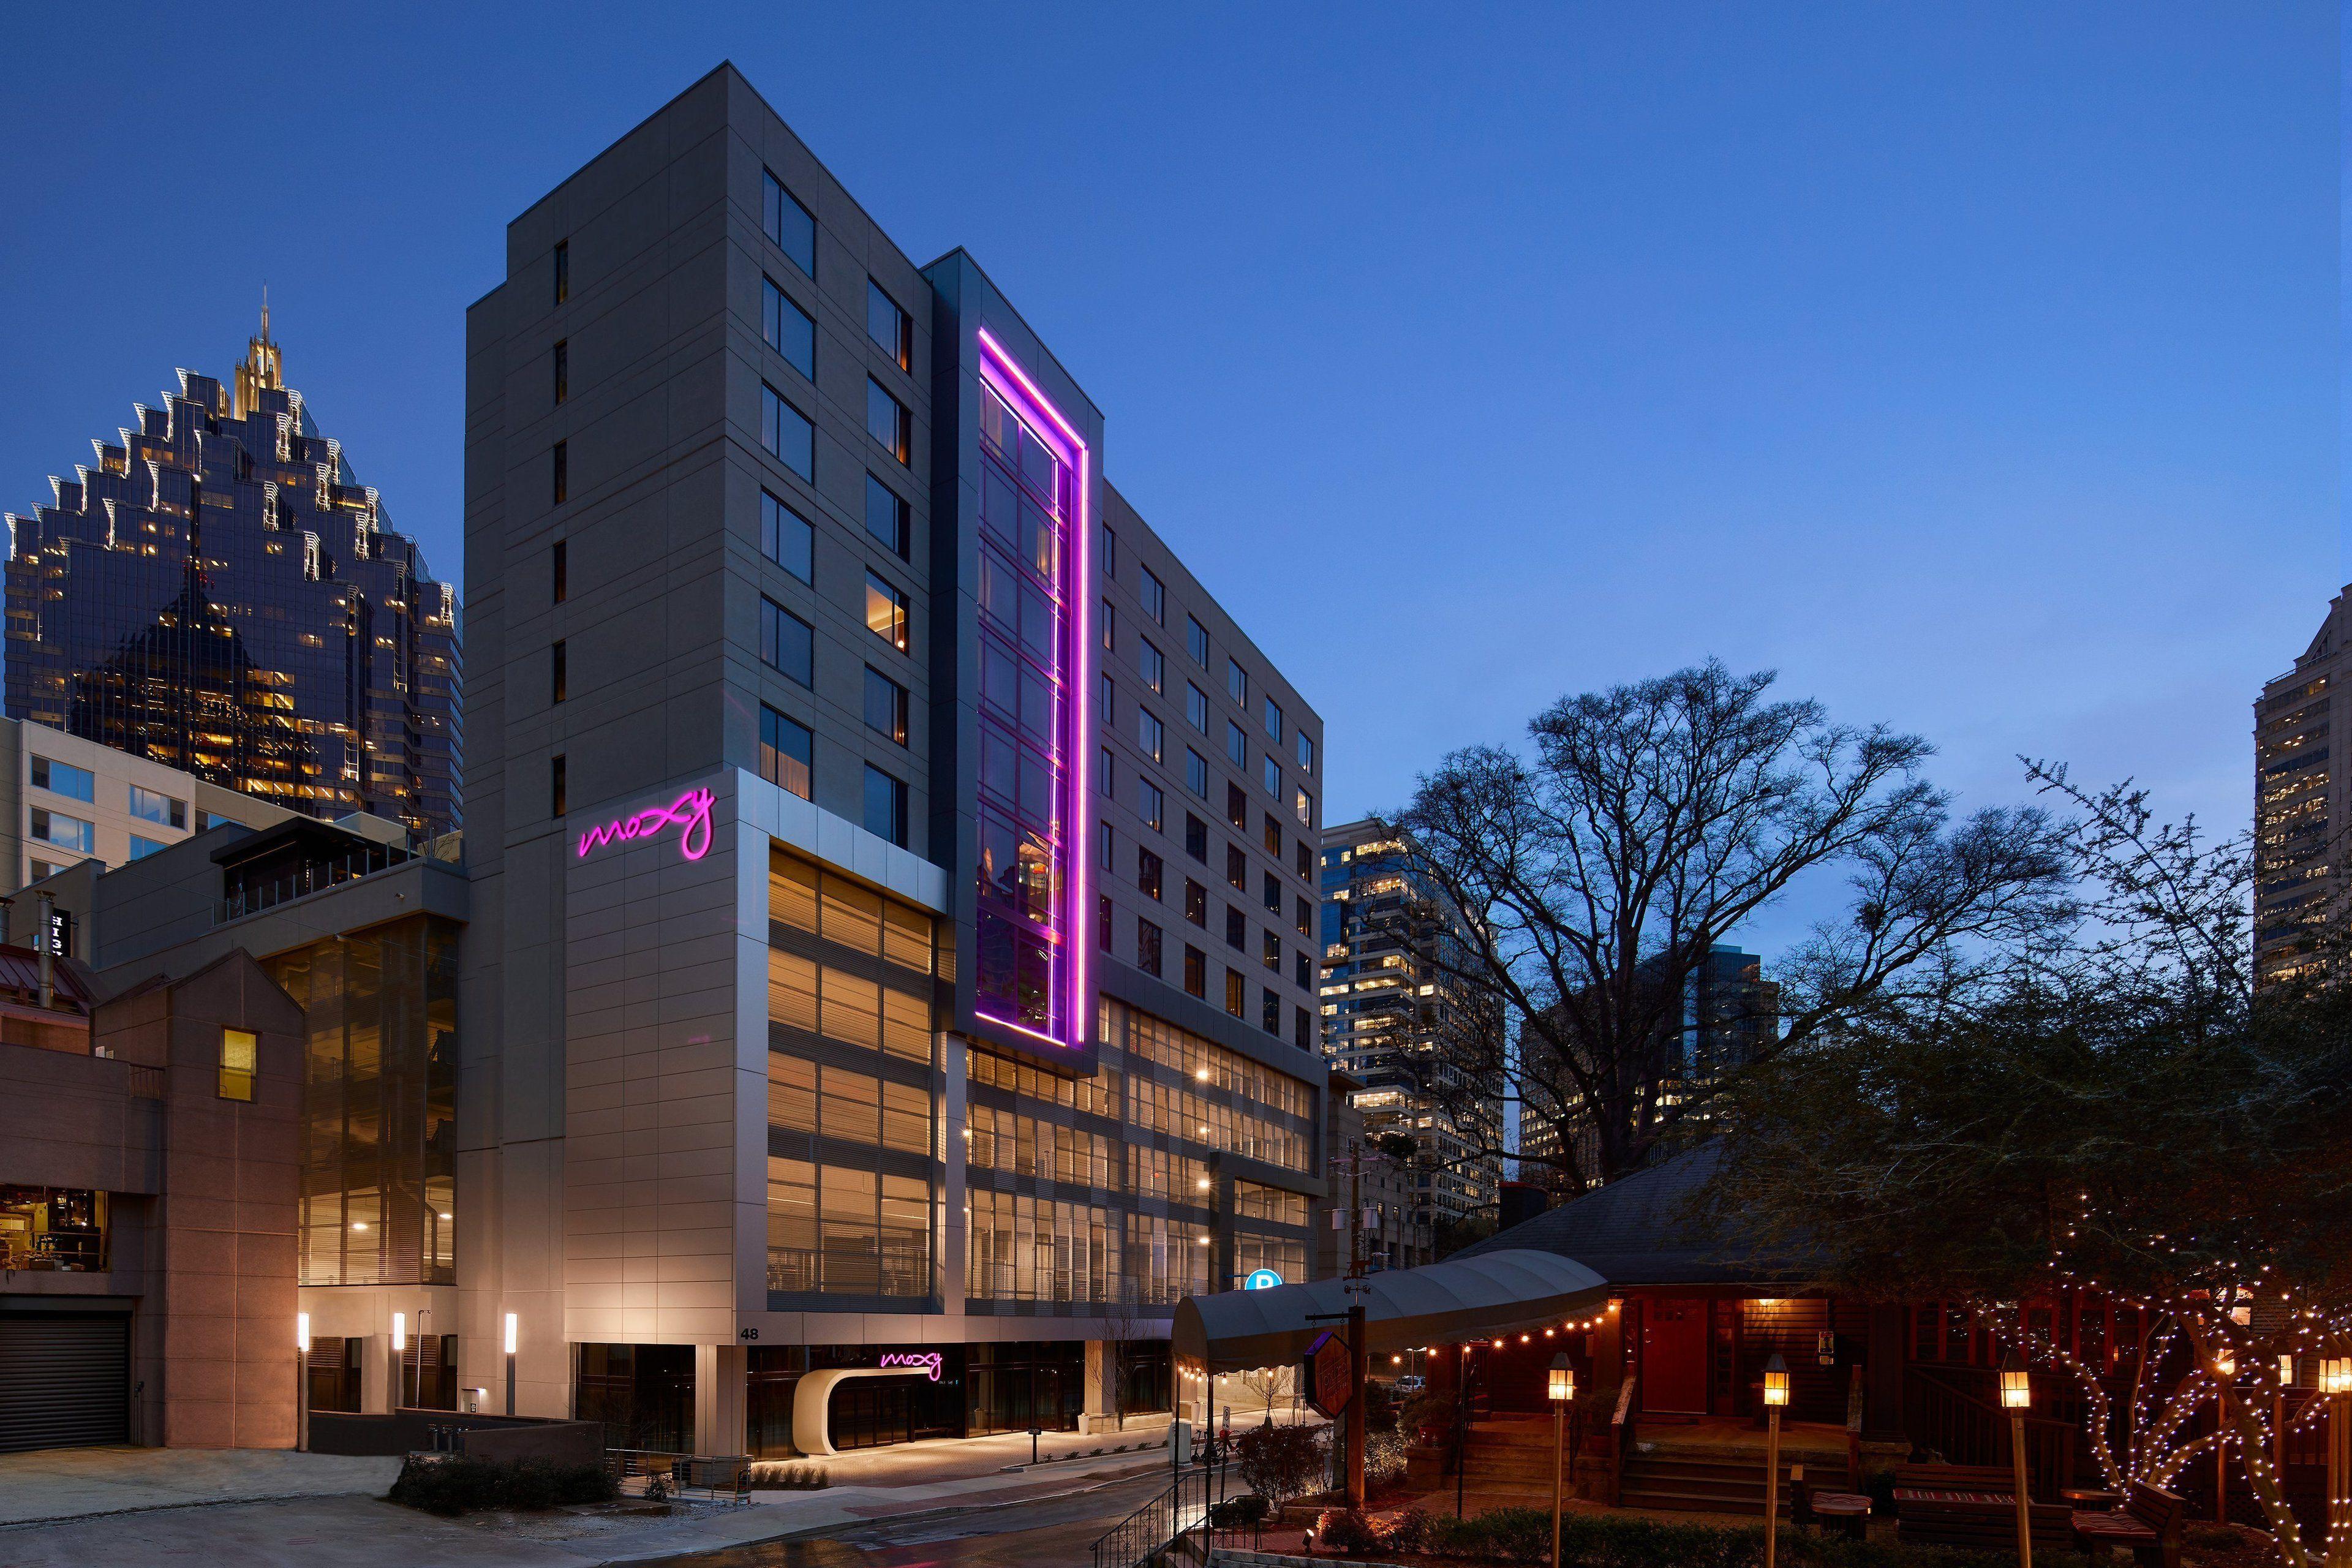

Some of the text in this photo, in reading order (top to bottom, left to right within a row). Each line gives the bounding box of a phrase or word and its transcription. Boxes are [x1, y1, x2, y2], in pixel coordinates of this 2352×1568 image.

[579, 788, 717, 860] moxy
[1256, 1275, 1274, 1290] P
[741, 1328, 759, 1340] 48
[880, 1352, 943, 1381] moxy
